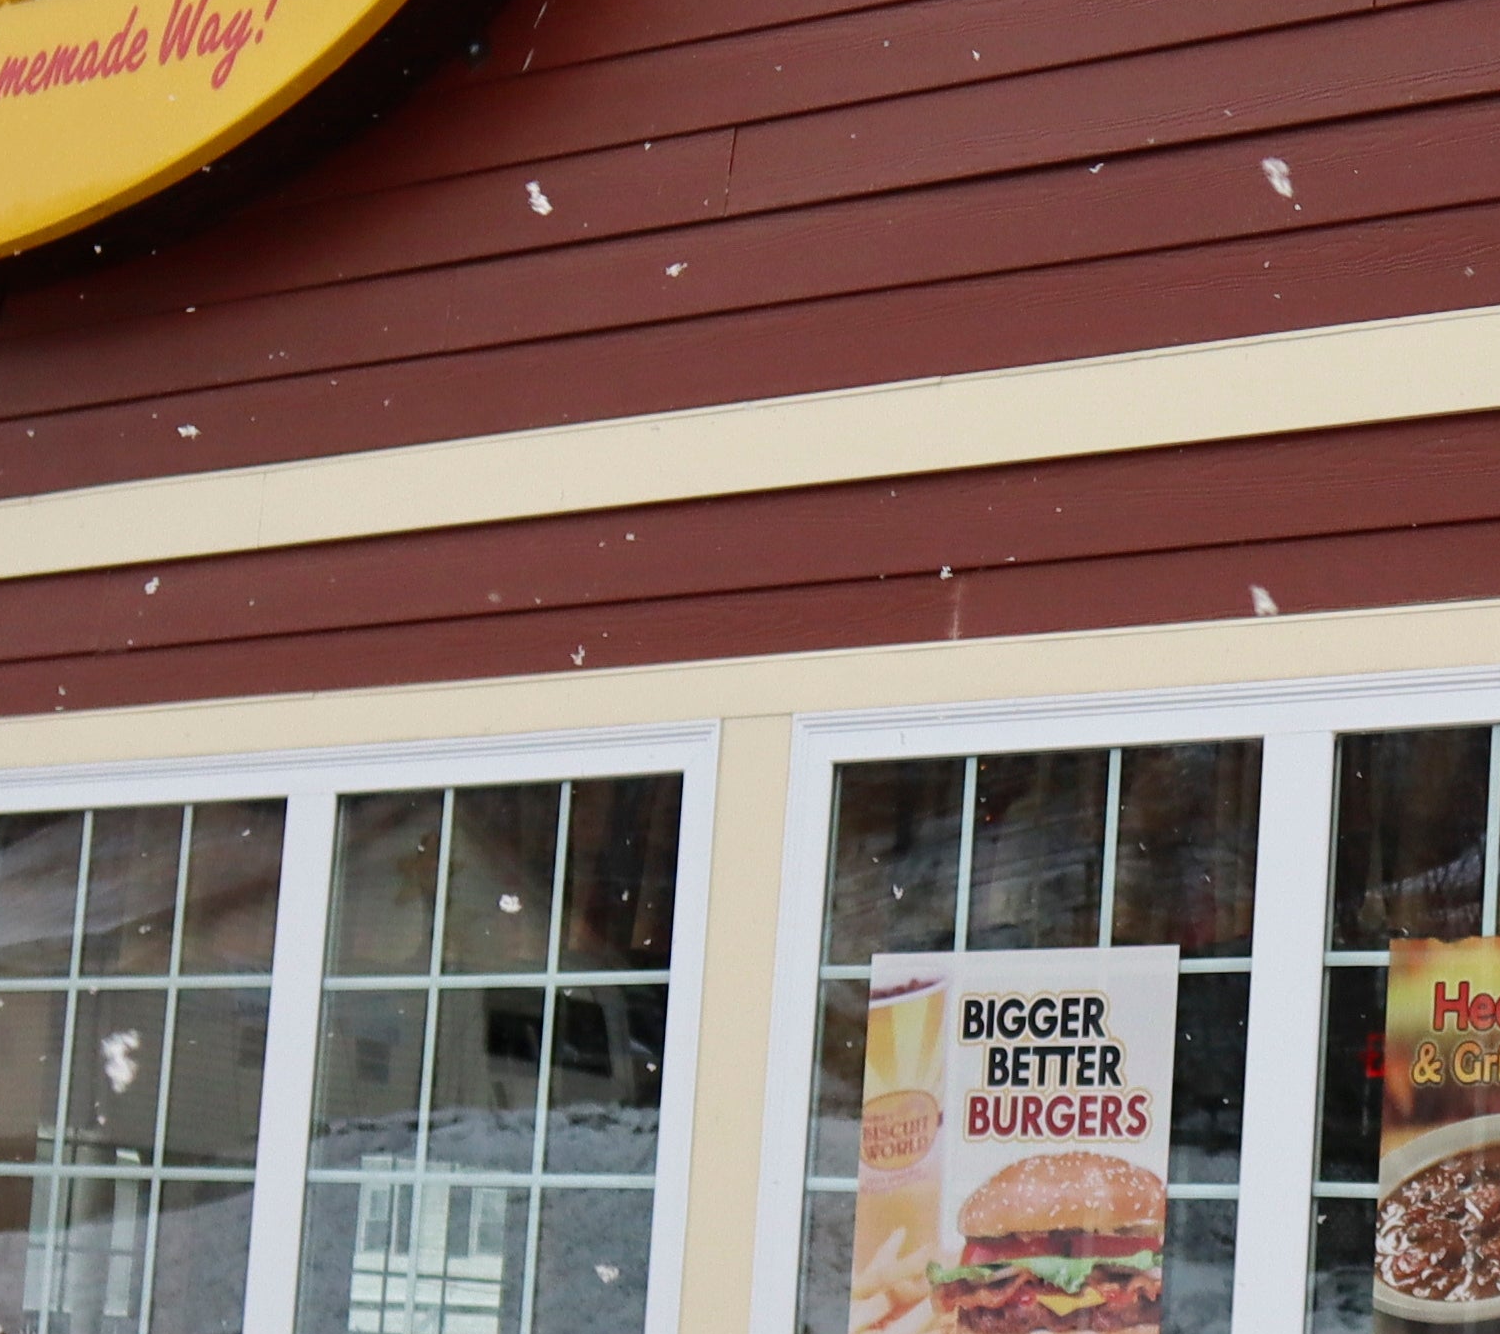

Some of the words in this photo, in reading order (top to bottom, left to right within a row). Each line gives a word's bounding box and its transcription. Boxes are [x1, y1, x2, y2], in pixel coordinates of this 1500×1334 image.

[963, 997, 1106, 1039] BIGGER
[987, 1045, 1122, 1087] BETTER
[1411, 1042, 1443, 1084] &
[968, 1094, 1148, 1137] BURGERS
